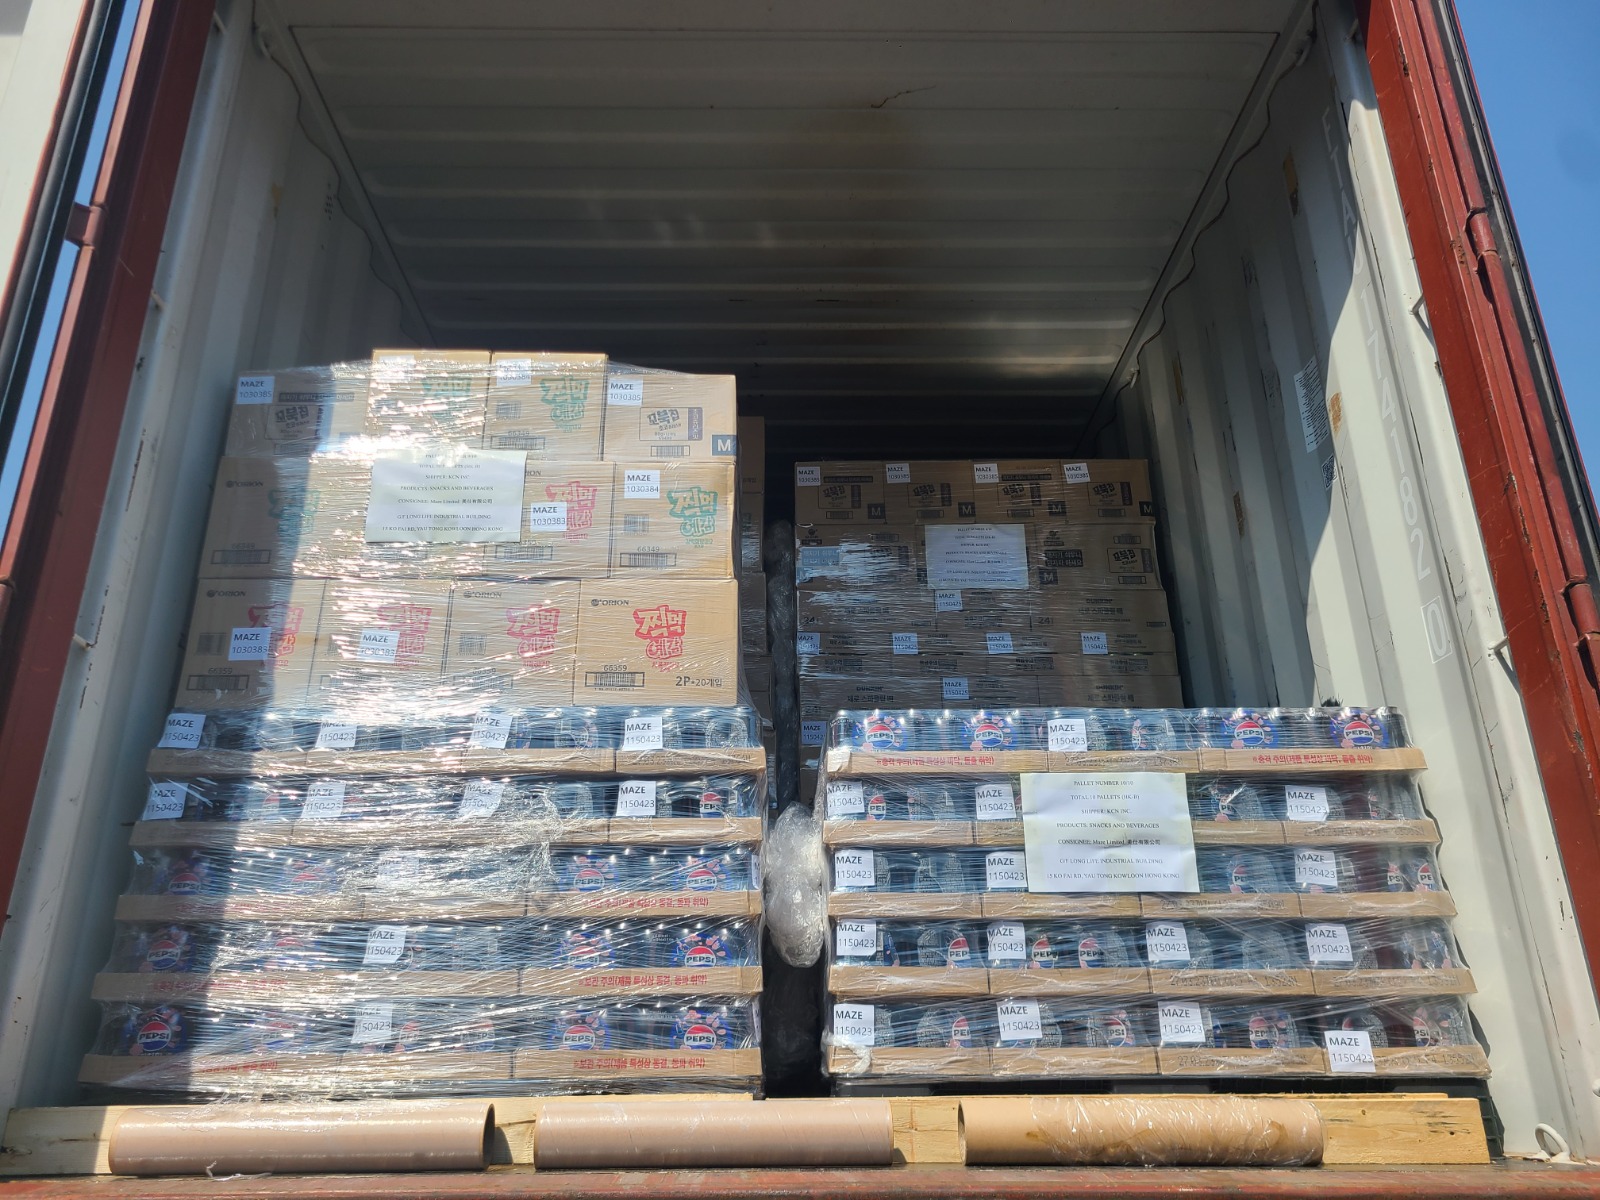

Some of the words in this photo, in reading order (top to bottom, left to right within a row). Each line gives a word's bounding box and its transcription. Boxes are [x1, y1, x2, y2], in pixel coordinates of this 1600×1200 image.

[241, 380, 265, 388] MAZE
[610, 382, 634, 391] MAZE
[718, 439, 732, 452] M
[667, 487, 718, 518] 찍먹
[532, 517, 566, 525] 1030383
[633, 605, 687, 639] 찍먹
[234, 633, 260, 641] MAZE
[363, 635, 389, 643] MAZE
[168, 719, 194, 728] MAZE
[475, 717, 501, 727] MAZE
[626, 722, 651, 731] MAZE
[1050, 724, 1076, 733] MAZE
[1237, 729, 1263, 737] PEPSI
[1345, 729, 1373, 737] PEPSI
[164, 732, 200, 742] 1150423
[472, 731, 507, 743] 1150423
[626, 736, 661, 744] 1150423
[975, 731, 1001, 740] PEPSI
[1050, 737, 1086, 746] 1150423
[620, 786, 646, 795] MAZE
[828, 784, 852, 794] MAZE
[977, 789, 1003, 799] MAZE
[1288, 791, 1316, 801] MAZE
[620, 799, 655, 809] 1150423
[979, 802, 1014, 812] 1150423
[1289, 804, 1327, 814] 1150423
[836, 856, 863, 865] MAZE
[988, 857, 1015, 866] MAZE
[836, 870, 872, 879] 1150423
[988, 871, 1025, 881] 1150423
[1297, 866, 1336, 879] 1150423
[575, 877, 603, 885] PEPSI
[687, 877, 716, 886] PEPSI
[838, 924, 866, 933] MAZE
[988, 927, 1014, 938] MAZE
[1148, 928, 1175, 938] MAZE
[369, 930, 395, 940] MAZE
[1308, 930, 1337, 939] MAZE
[838, 938, 875, 948] 1150423
[1148, 943, 1188, 953] 1150423
[1310, 943, 1350, 954] 1150423
[148, 951, 179, 961] PEPSI
[686, 956, 715, 964] PEPSI
[835, 1010, 863, 1020] MAZE
[1000, 1005, 1028, 1015] MAZE
[1161, 1008, 1190, 1018] MAZE
[835, 1025, 873, 1037] 1150423
[1002, 1020, 1040, 1032] 1150423
[1163, 1025, 1204, 1034] 1150423
[140, 1032, 169, 1040] PEPSI
[564, 1035, 594, 1044] PEPSI
[685, 1034, 716, 1044] PEPSI
[1329, 1037, 1360, 1047] MAZE
[1332, 1053, 1374, 1064] 1150423
